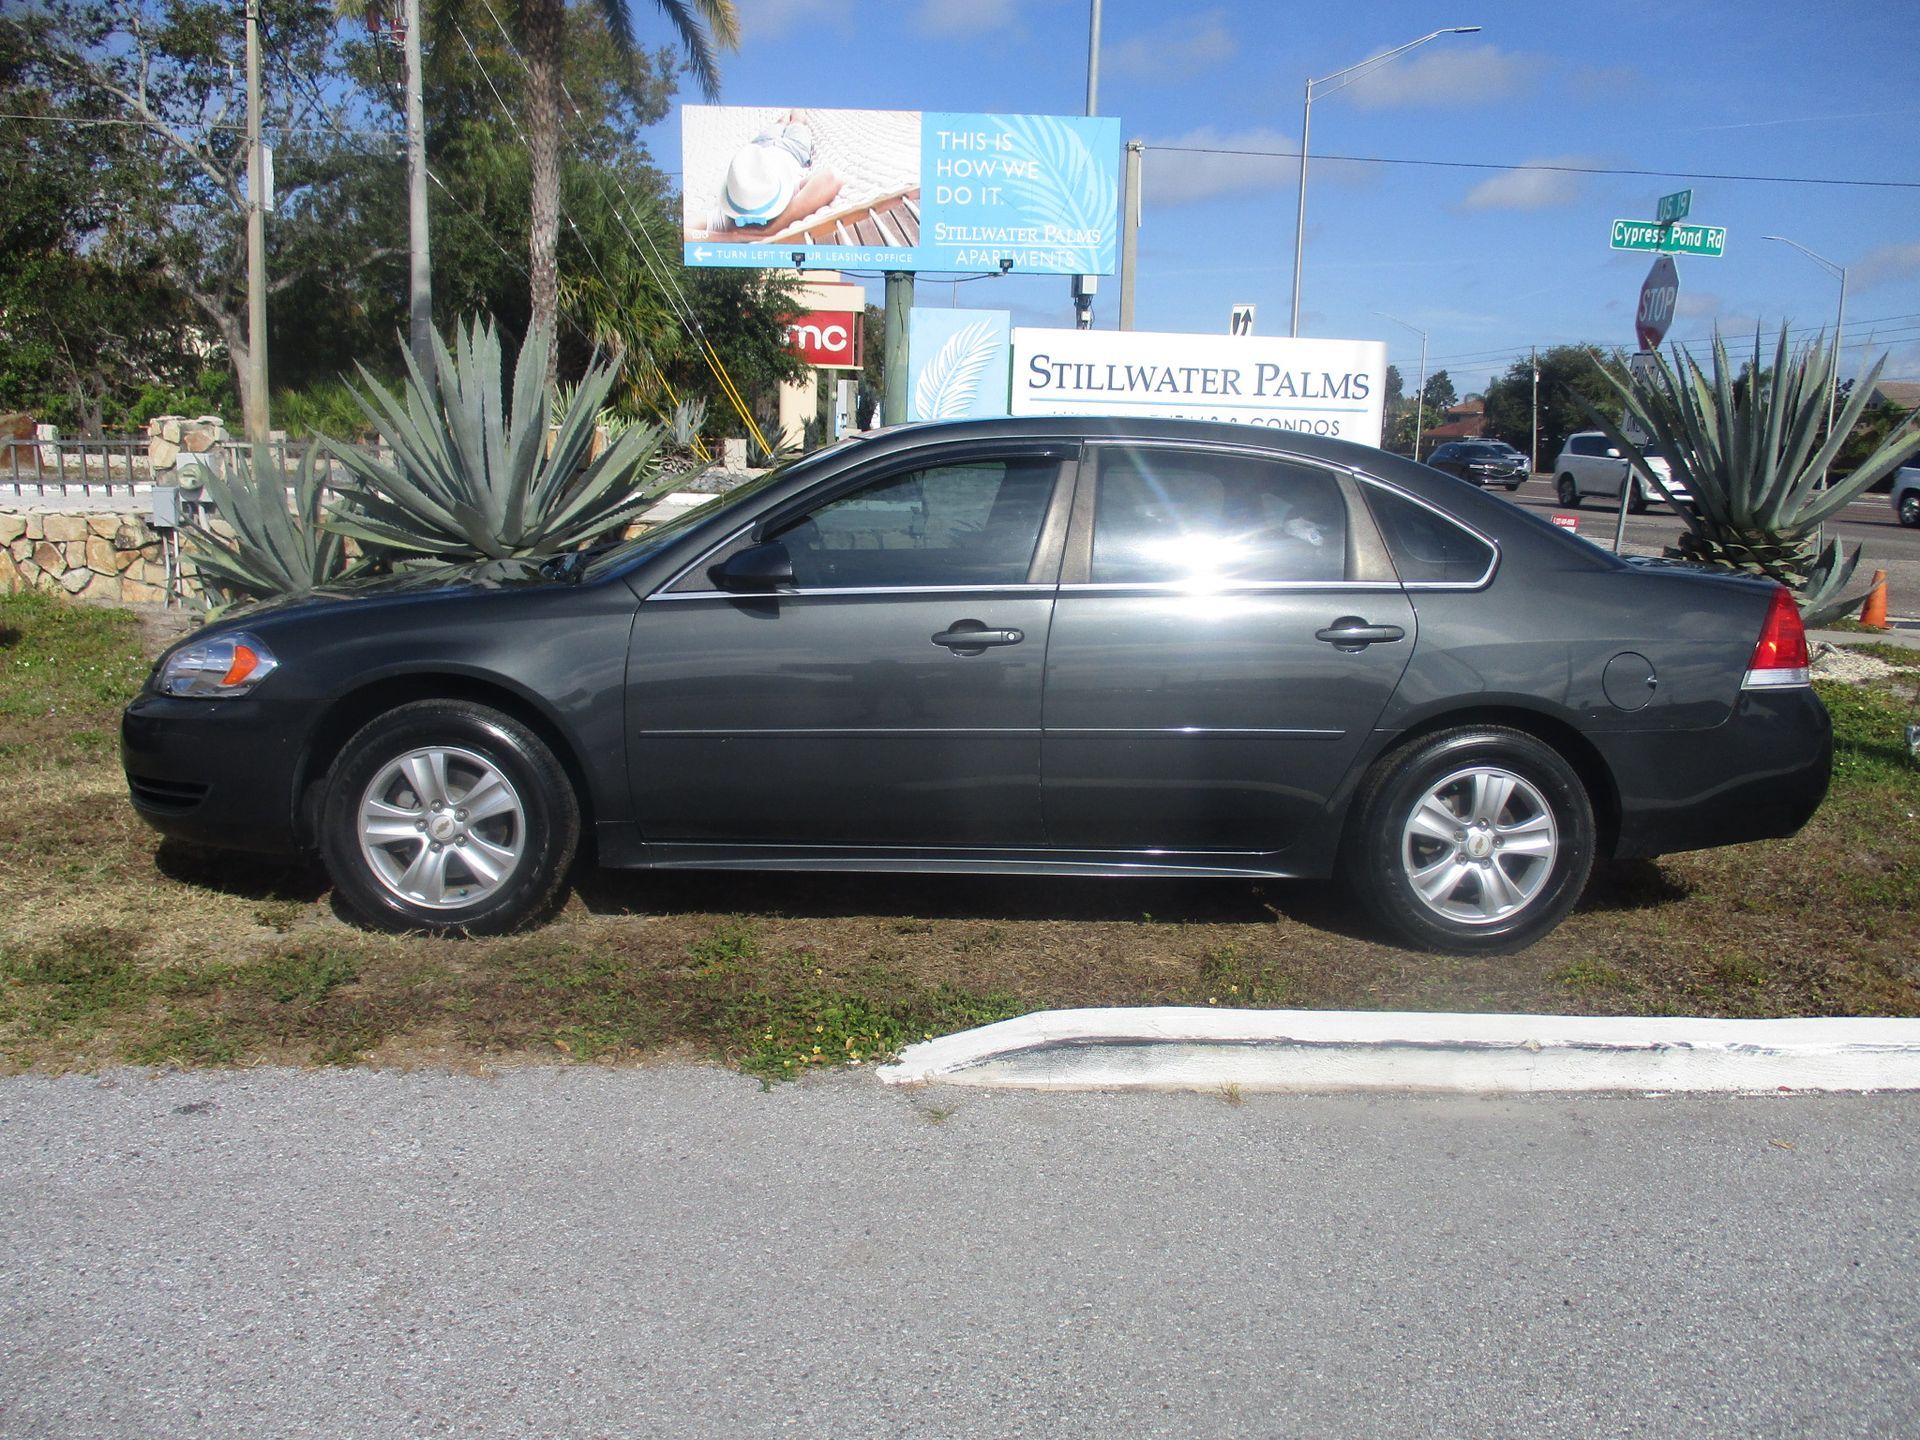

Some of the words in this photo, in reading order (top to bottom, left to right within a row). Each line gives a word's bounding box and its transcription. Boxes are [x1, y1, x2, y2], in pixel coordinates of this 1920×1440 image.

[937, 131, 987, 151] THIS
[996, 132, 1013, 151] IS
[937, 159, 997, 178] HOW
[1002, 160, 1039, 179] WE
[937, 186, 972, 205] DO
[981, 187, 1004, 206] IT.
[1660, 197, 1673, 220] US
[1677, 192, 1688, 218] 19
[935, 222, 1038, 243] STILLWATER
[1042, 224, 1101, 243] PALMS
[1614, 223, 1666, 246] Cypress
[1671, 227, 1702, 247] Pond
[1707, 230, 1723, 249] Rd
[717, 250, 747, 259] TURN
[751, 250, 775, 260] LEFT
[779, 251, 792, 260] TO
[826, 252, 871, 262] LEASING
[875, 253, 913, 263] OFFICE
[955, 249, 1075, 267] APARTMENTS
[1638, 287, 1675, 321] STOP
[780, 325, 848, 351] mc
[1028, 354, 1242, 396] STILLWATER
[1253, 363, 1370, 401] PALMS
